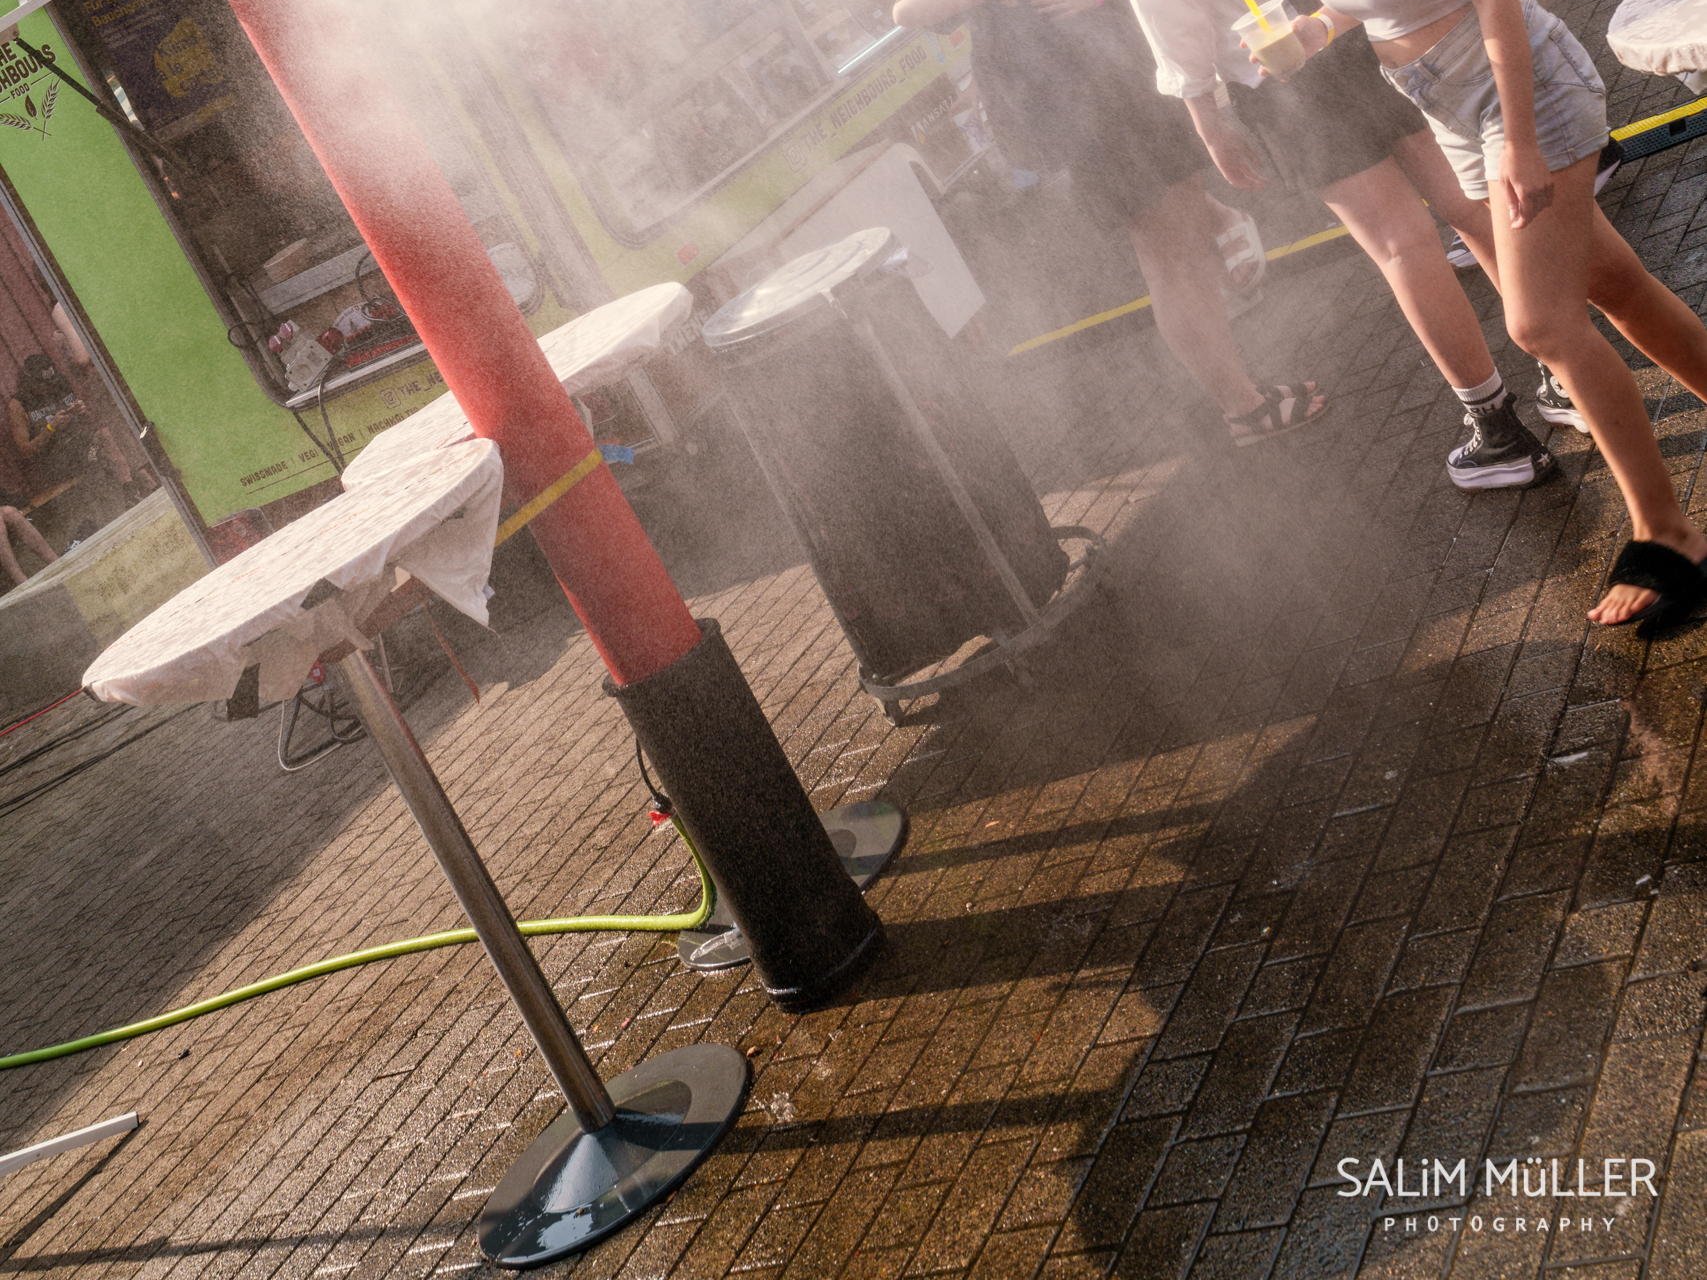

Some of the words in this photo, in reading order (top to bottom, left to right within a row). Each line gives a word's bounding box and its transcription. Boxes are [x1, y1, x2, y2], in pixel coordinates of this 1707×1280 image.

[10, 83, 31, 99] FOOD
[240, 461, 288, 487] SWISSMADE
[327, 432, 356, 451] VGAN
